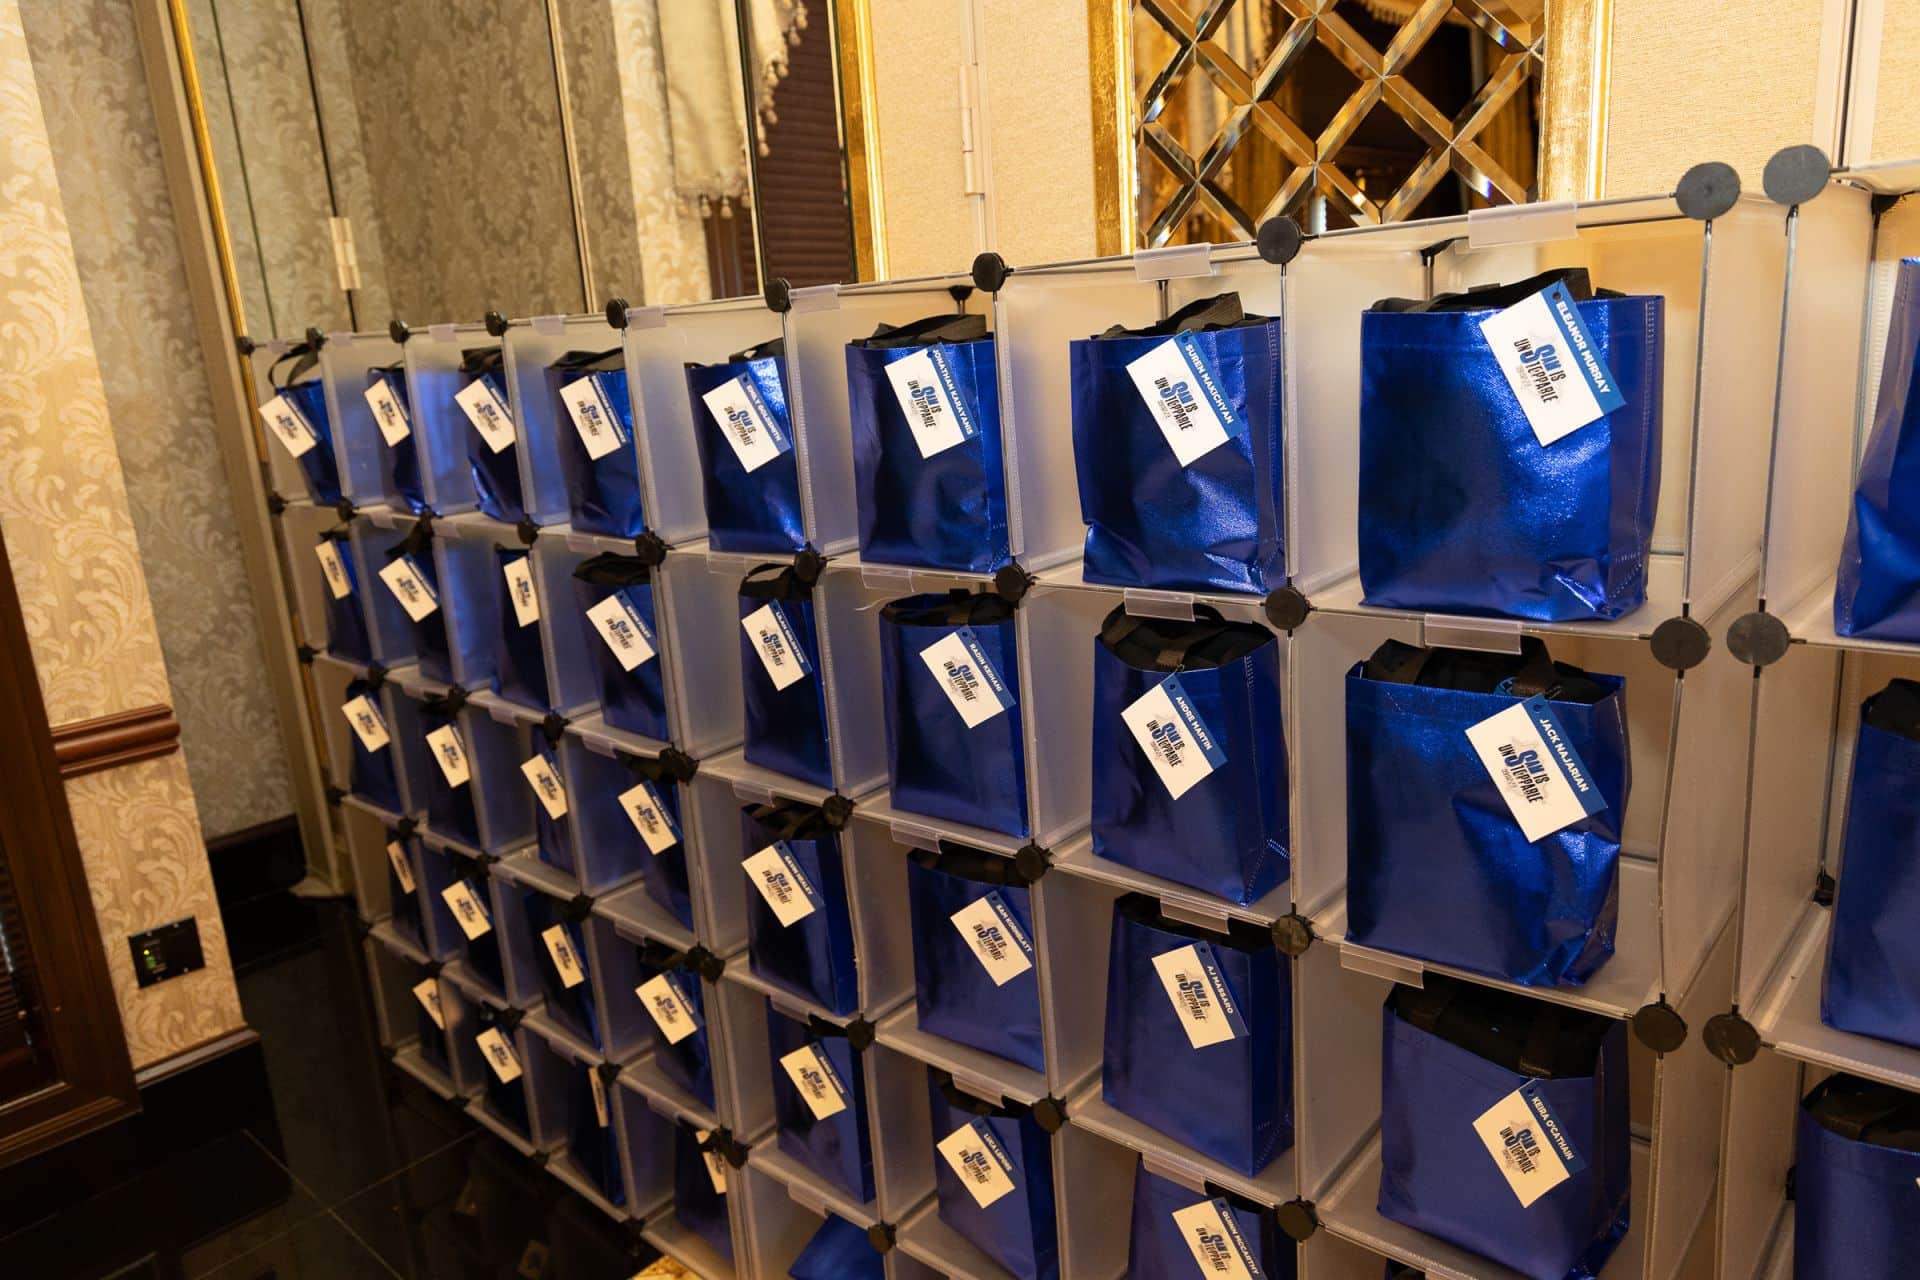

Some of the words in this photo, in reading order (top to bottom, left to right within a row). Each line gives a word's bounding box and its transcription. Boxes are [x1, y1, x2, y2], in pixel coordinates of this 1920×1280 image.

[1185, 344, 1206, 374] SUREN
[1556, 301, 1587, 353] ELEANOR
[1581, 350, 1611, 393] MURRAY
[933, 350, 954, 392] JONATHAN
[1520, 344, 1562, 371] SAM
[1549, 371, 1566, 382] IS
[931, 405, 942, 413] IS
[1160, 381, 1194, 404] SAM
[1185, 403, 1198, 412] IS
[1152, 722, 1181, 743] SAM
[1174, 741, 1185, 750] IS
[1176, 697, 1195, 722] ANDRE
[1192, 721, 1213, 750] MARTIN
[1504, 750, 1544, 775] SAM
[1534, 773, 1550, 784] IS
[1540, 719, 1560, 744] JACK
[1555, 743, 1589, 793] NAJARIAN
[1179, 980, 1208, 999] SAM
[1208, 966, 1216, 975] AJ
[1213, 976, 1233, 1014] MASSARO
[1532, 1097, 1550, 1120] KEIRA
[1505, 1129, 1537, 1149] SAM
[1527, 1147, 1541, 1156] IS
[1222, 1211, 1238, 1235] QUINN
